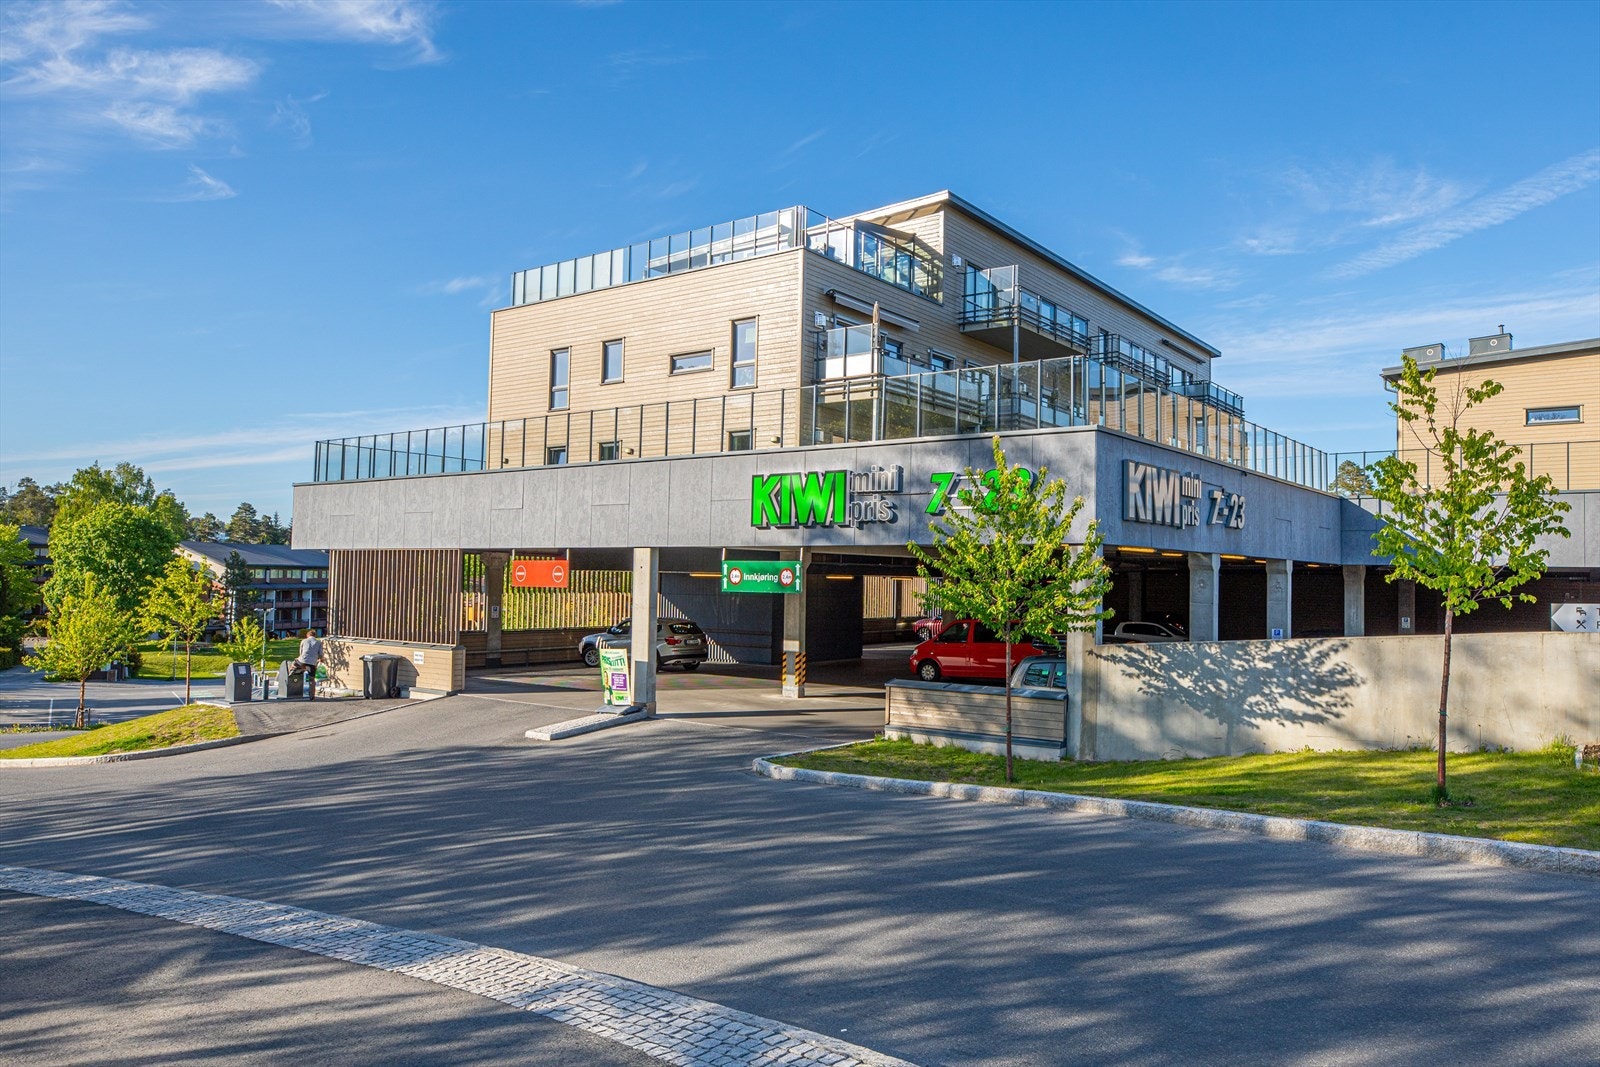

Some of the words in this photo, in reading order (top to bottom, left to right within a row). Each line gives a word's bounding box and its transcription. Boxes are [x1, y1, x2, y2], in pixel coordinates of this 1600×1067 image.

[851, 464, 901, 493] mini
[1124, 460, 1180, 526] KIWI
[1181, 471, 1202, 499] mini
[751, 469, 849, 528] KIWI
[850, 494, 894, 527] pris
[1181, 499, 1200, 530] pris
[1208, 489, 1246, 529] 7-23
[743, 572, 779, 583] Innkjøring
